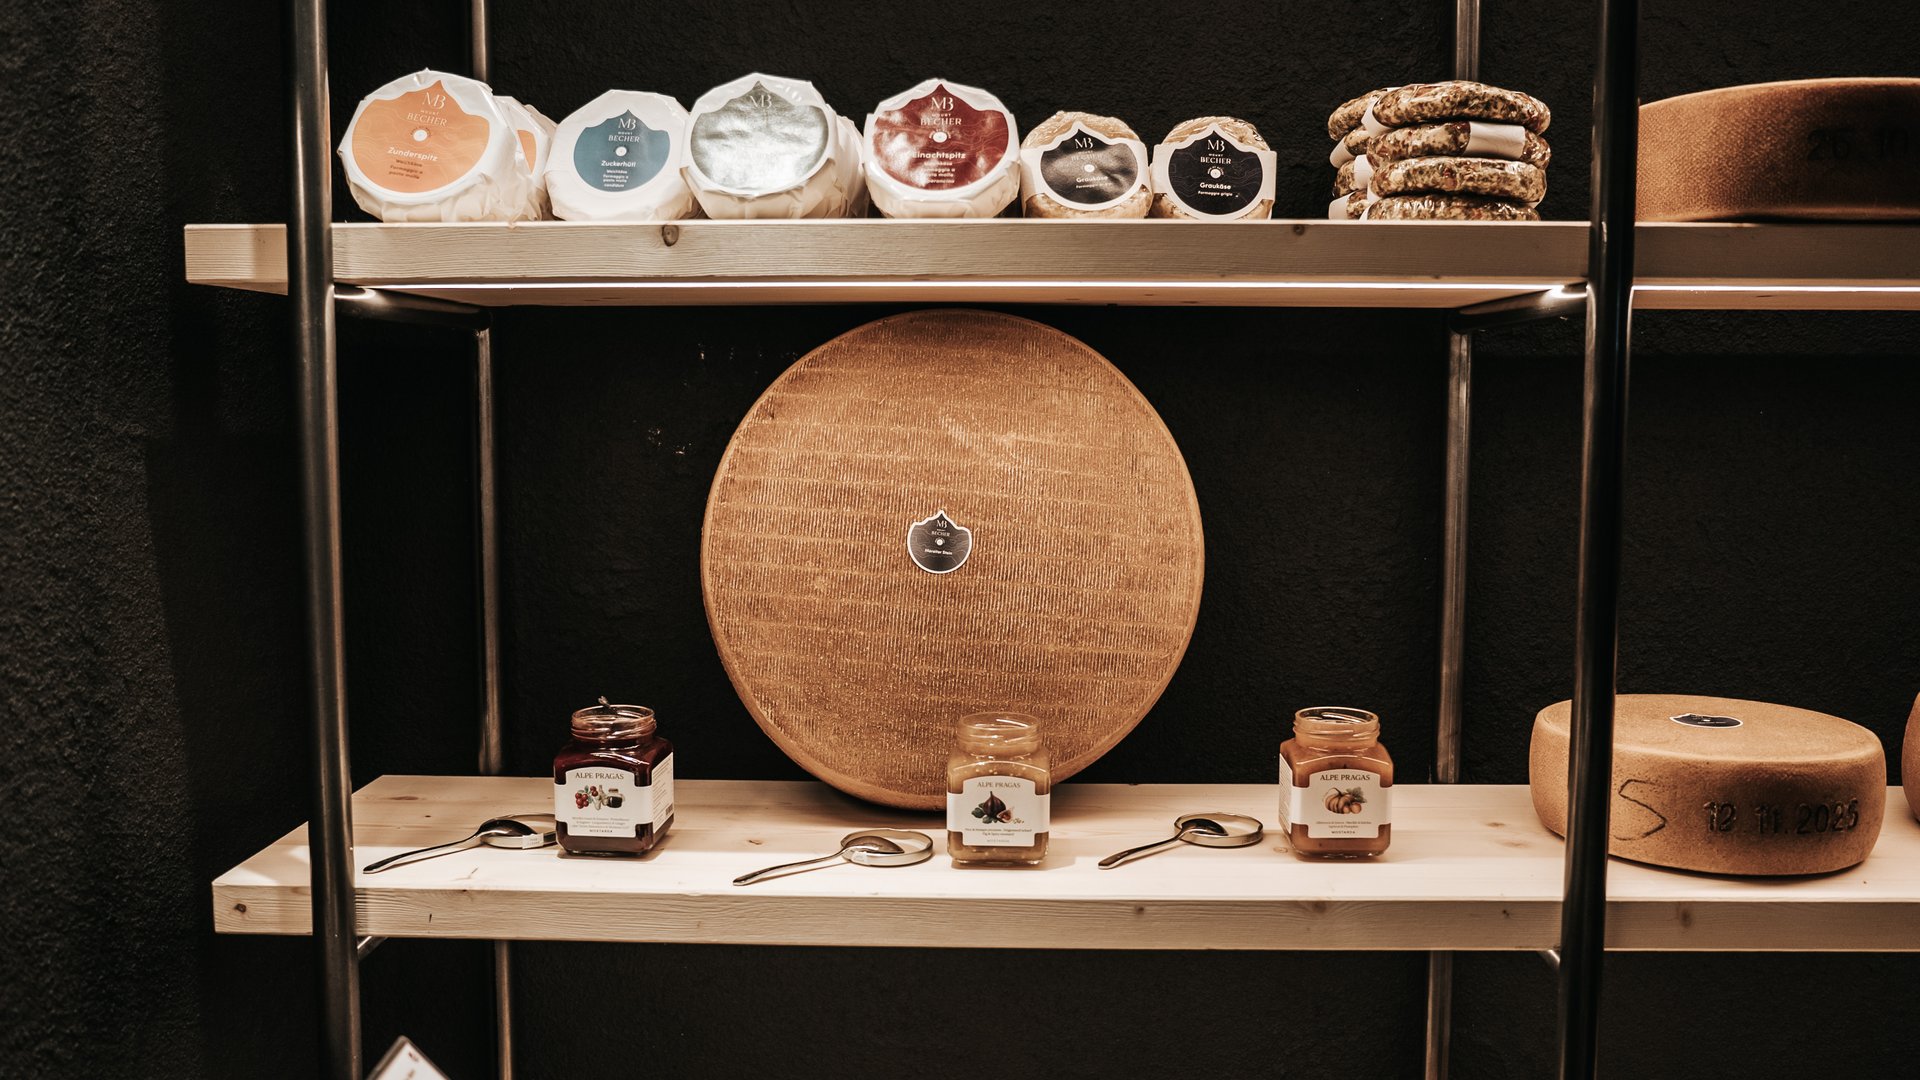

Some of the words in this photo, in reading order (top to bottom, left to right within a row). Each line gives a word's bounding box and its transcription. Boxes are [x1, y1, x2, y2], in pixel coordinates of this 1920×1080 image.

[406, 112, 448, 127] BECHER
[608, 134, 640, 142] BECHER
[387, 146, 439, 162] Zunderspitz
